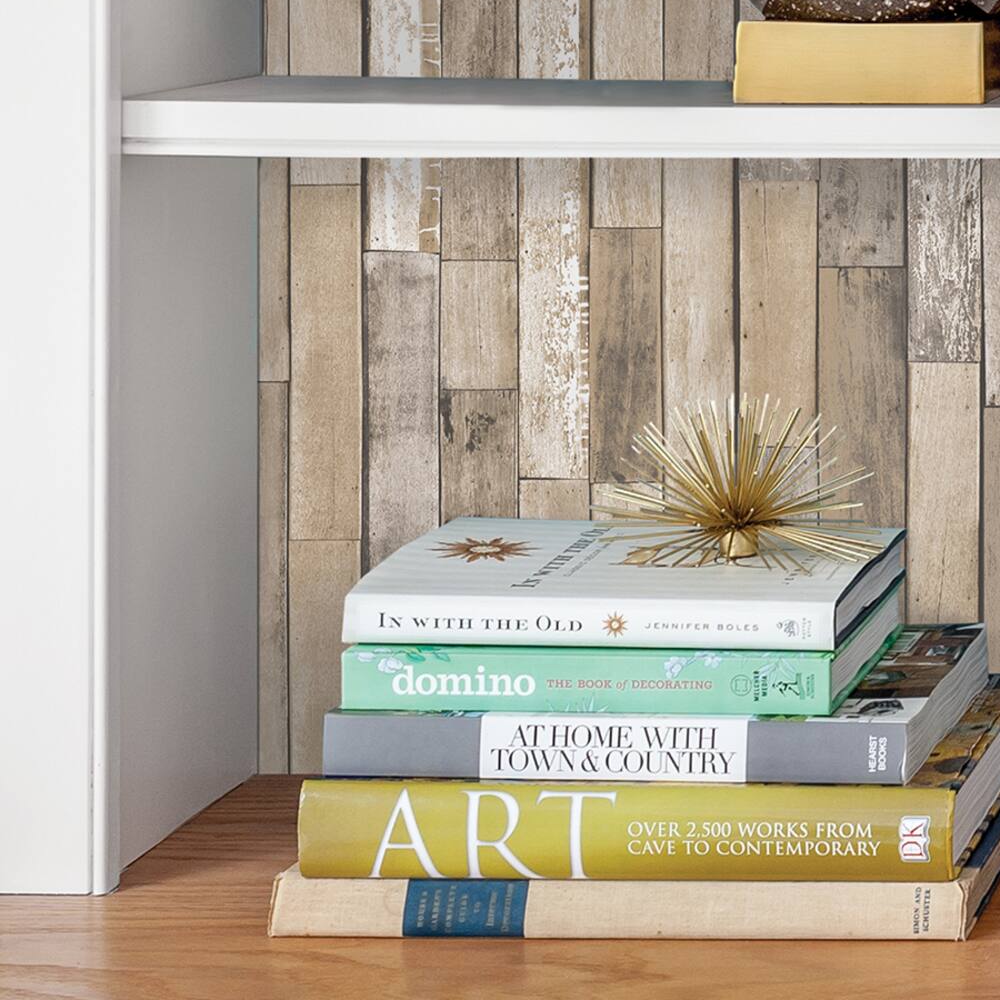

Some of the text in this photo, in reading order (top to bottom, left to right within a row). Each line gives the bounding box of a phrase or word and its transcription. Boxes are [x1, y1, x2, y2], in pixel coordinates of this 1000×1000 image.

[645, 622, 759, 632] JENNIFER BOLES
[392, 665, 536, 697] domino
[547, 679, 713, 691] THE BOOK of DECORATING
[508, 725, 719, 750] AT HOME WITH
[491, 749, 736, 775] TOWN & COUNTRY
[868, 735, 877, 773] HEARST
[877, 736, 887, 771] BOOKS
[368, 788, 616, 879] ART
[627, 822, 873, 839] OVER 2,500 WORKS FROM
[902, 823, 924, 858] DK
[627, 840, 881, 857] CAVE TO CONTEMPORARY
[922, 888, 931, 932] SCHUSTER
